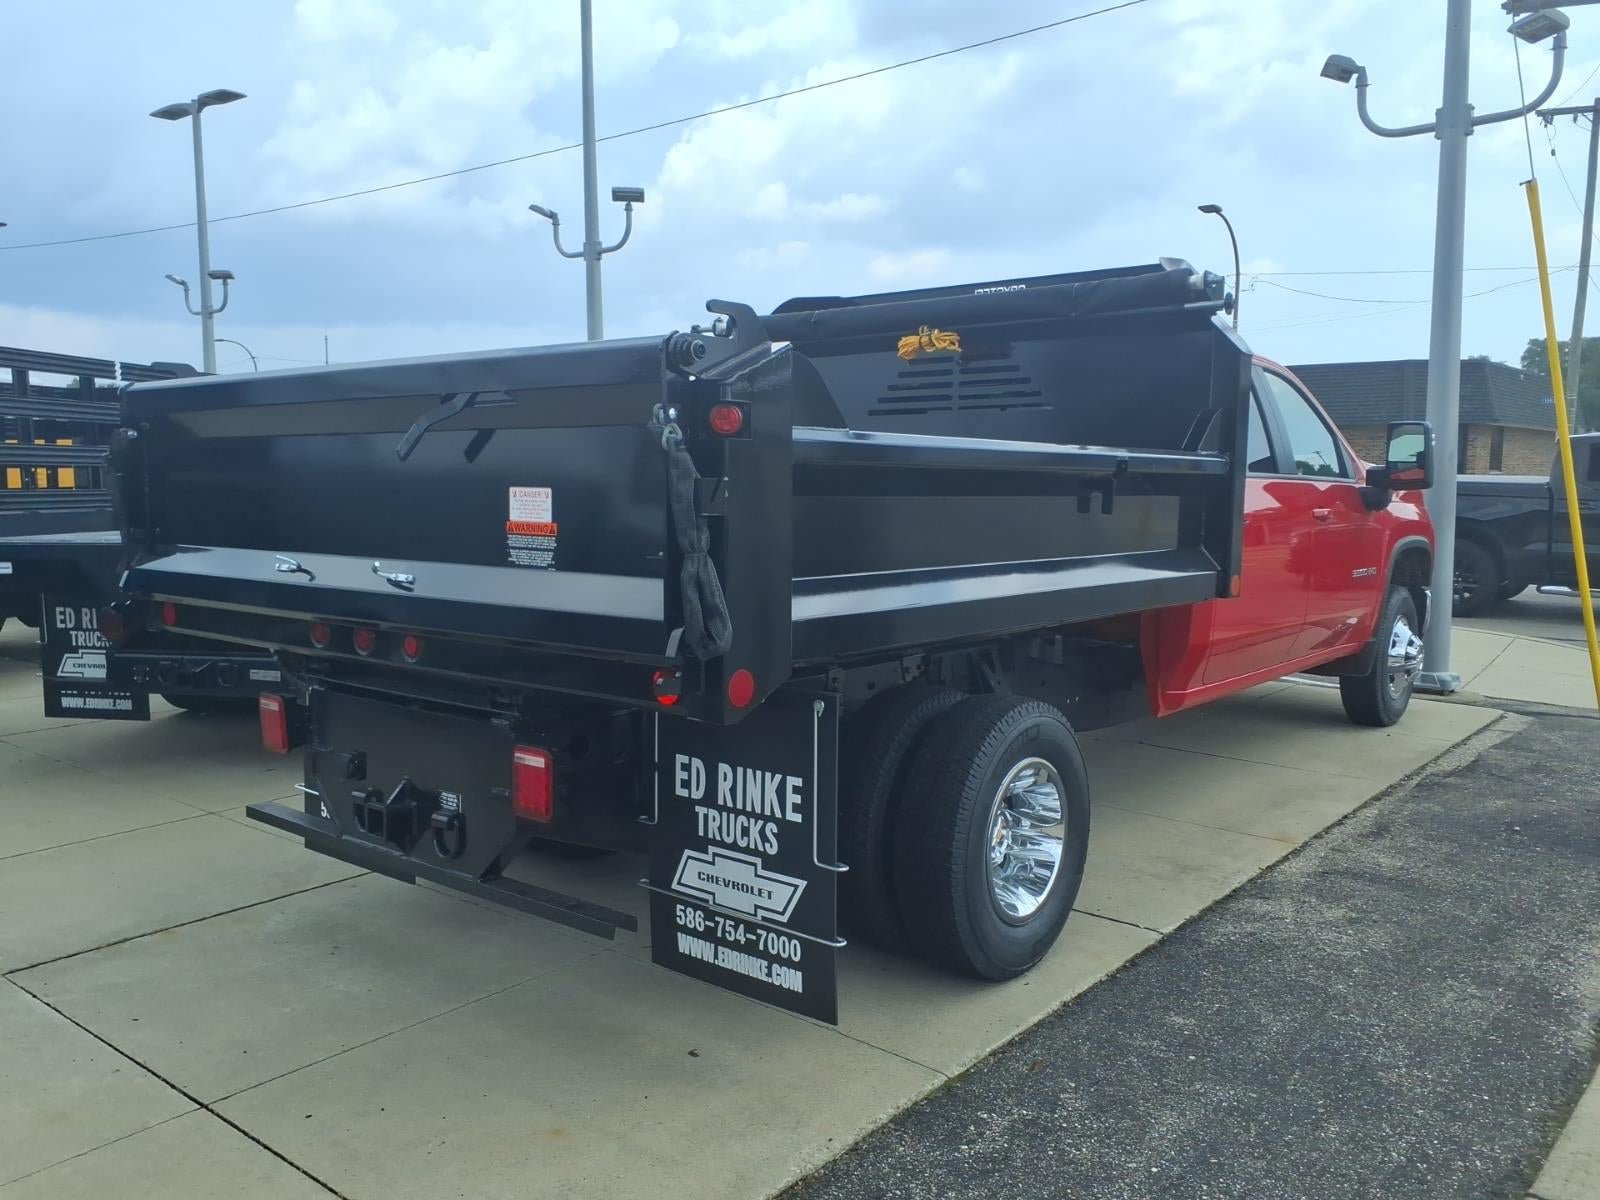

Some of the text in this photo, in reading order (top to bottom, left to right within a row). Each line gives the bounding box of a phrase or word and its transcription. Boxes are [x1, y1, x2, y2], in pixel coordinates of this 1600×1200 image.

[514, 522, 549, 534] WARNING
[55, 607, 75, 629] ED
[69, 630, 112, 647] TRUC
[675, 753, 803, 823] ED RINKE
[694, 806, 779, 856] TRUCKS
[697, 871, 774, 900] CHEVROLET
[675, 904, 802, 962] 586-754-7000
[676, 931, 803, 993] WWW.EDRINKE.COM
